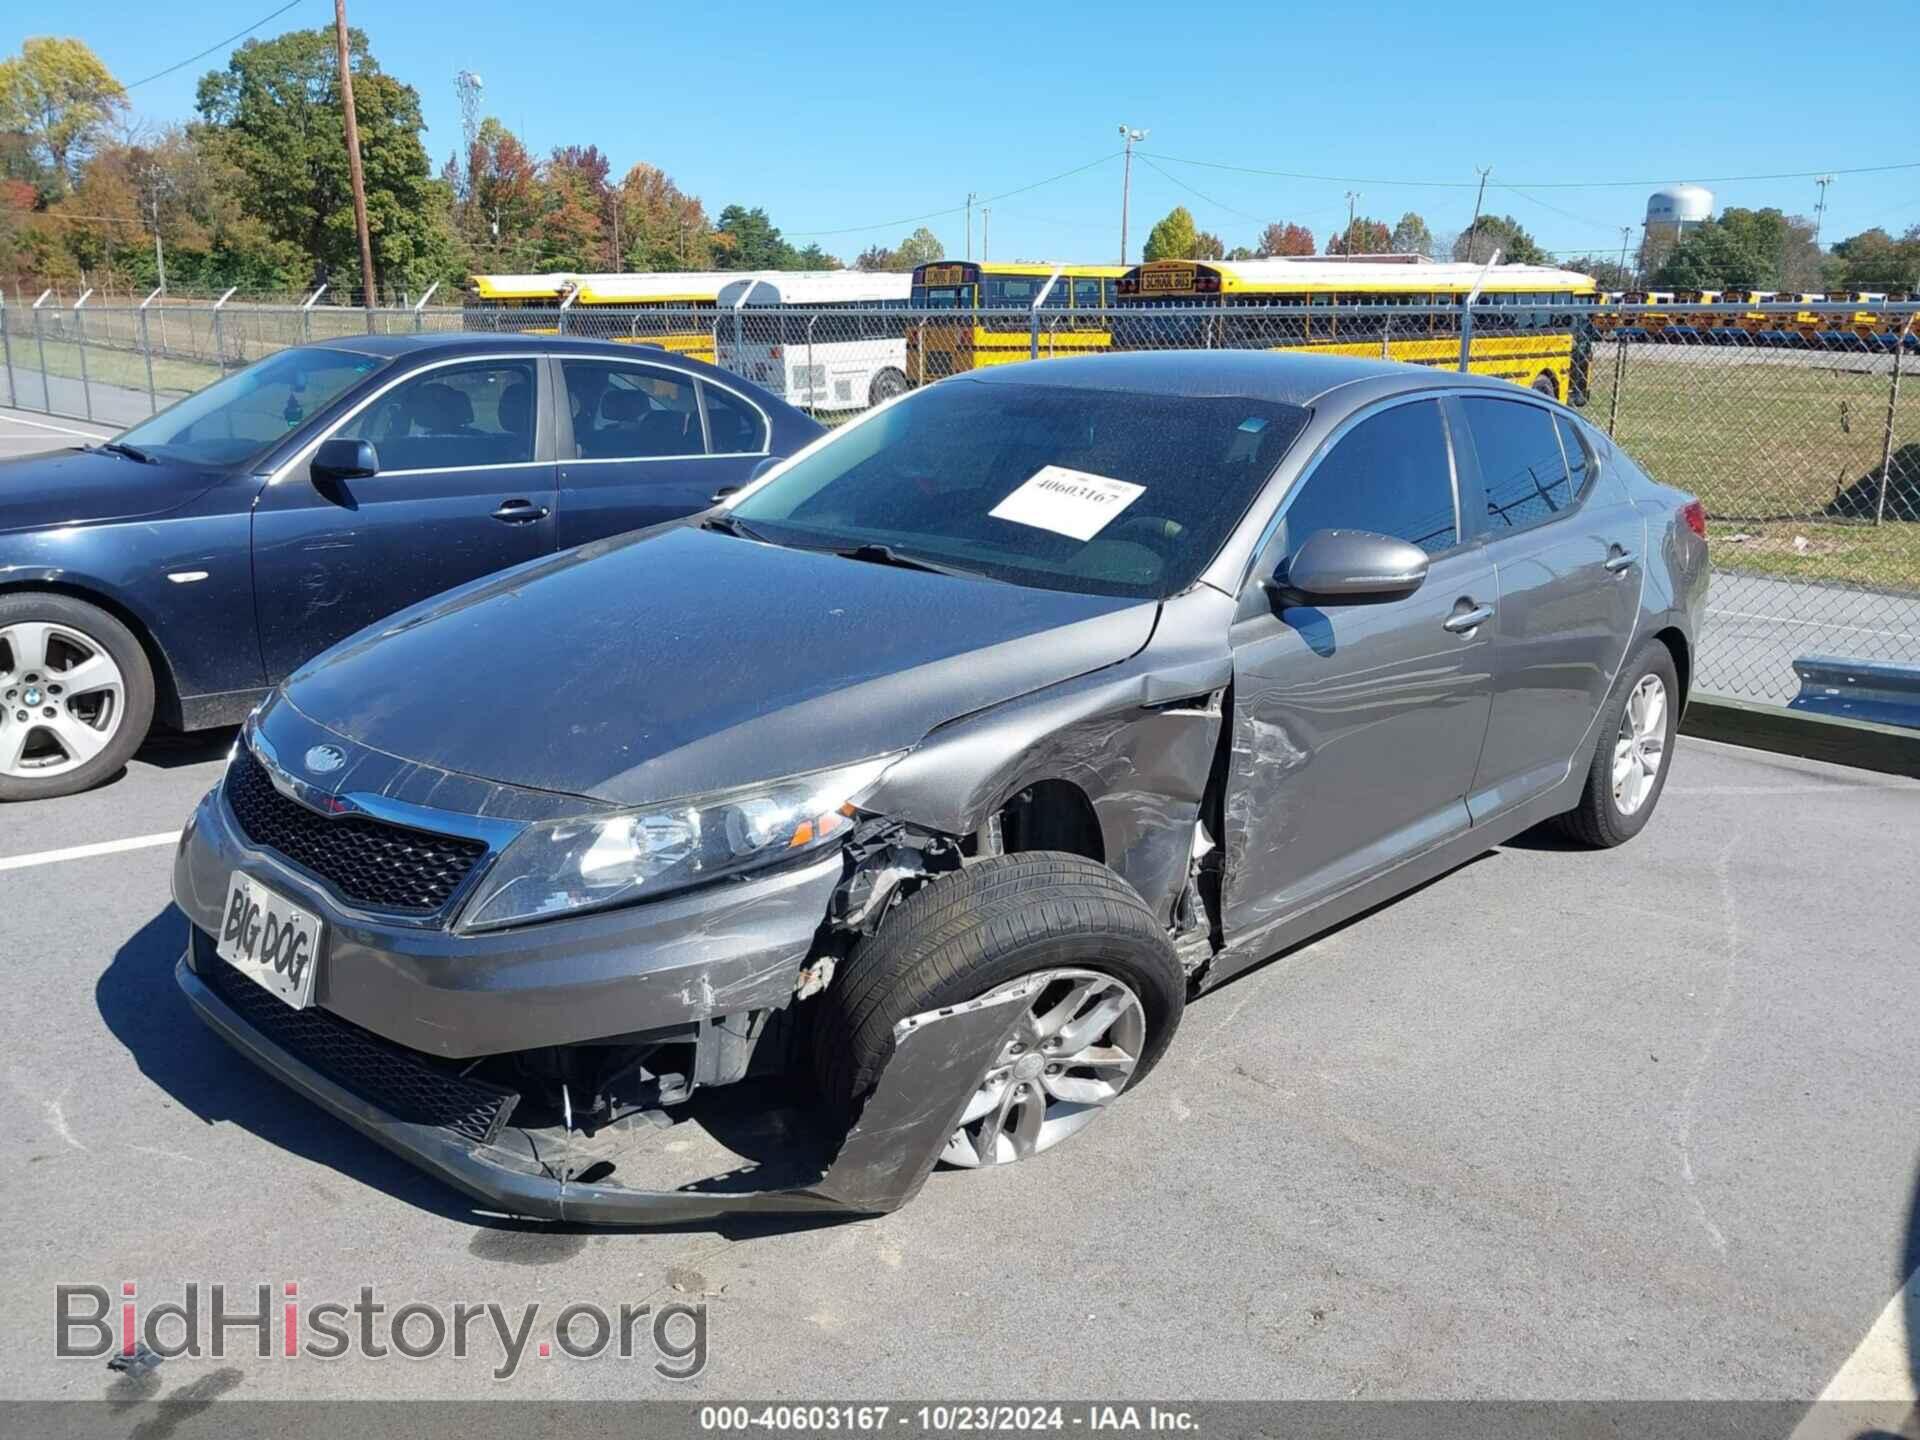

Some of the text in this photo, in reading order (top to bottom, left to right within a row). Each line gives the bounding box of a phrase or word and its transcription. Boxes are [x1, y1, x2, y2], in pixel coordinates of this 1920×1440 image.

[1036, 479, 1120, 504] 40603167
[224, 888, 309, 992] BIG DOG
